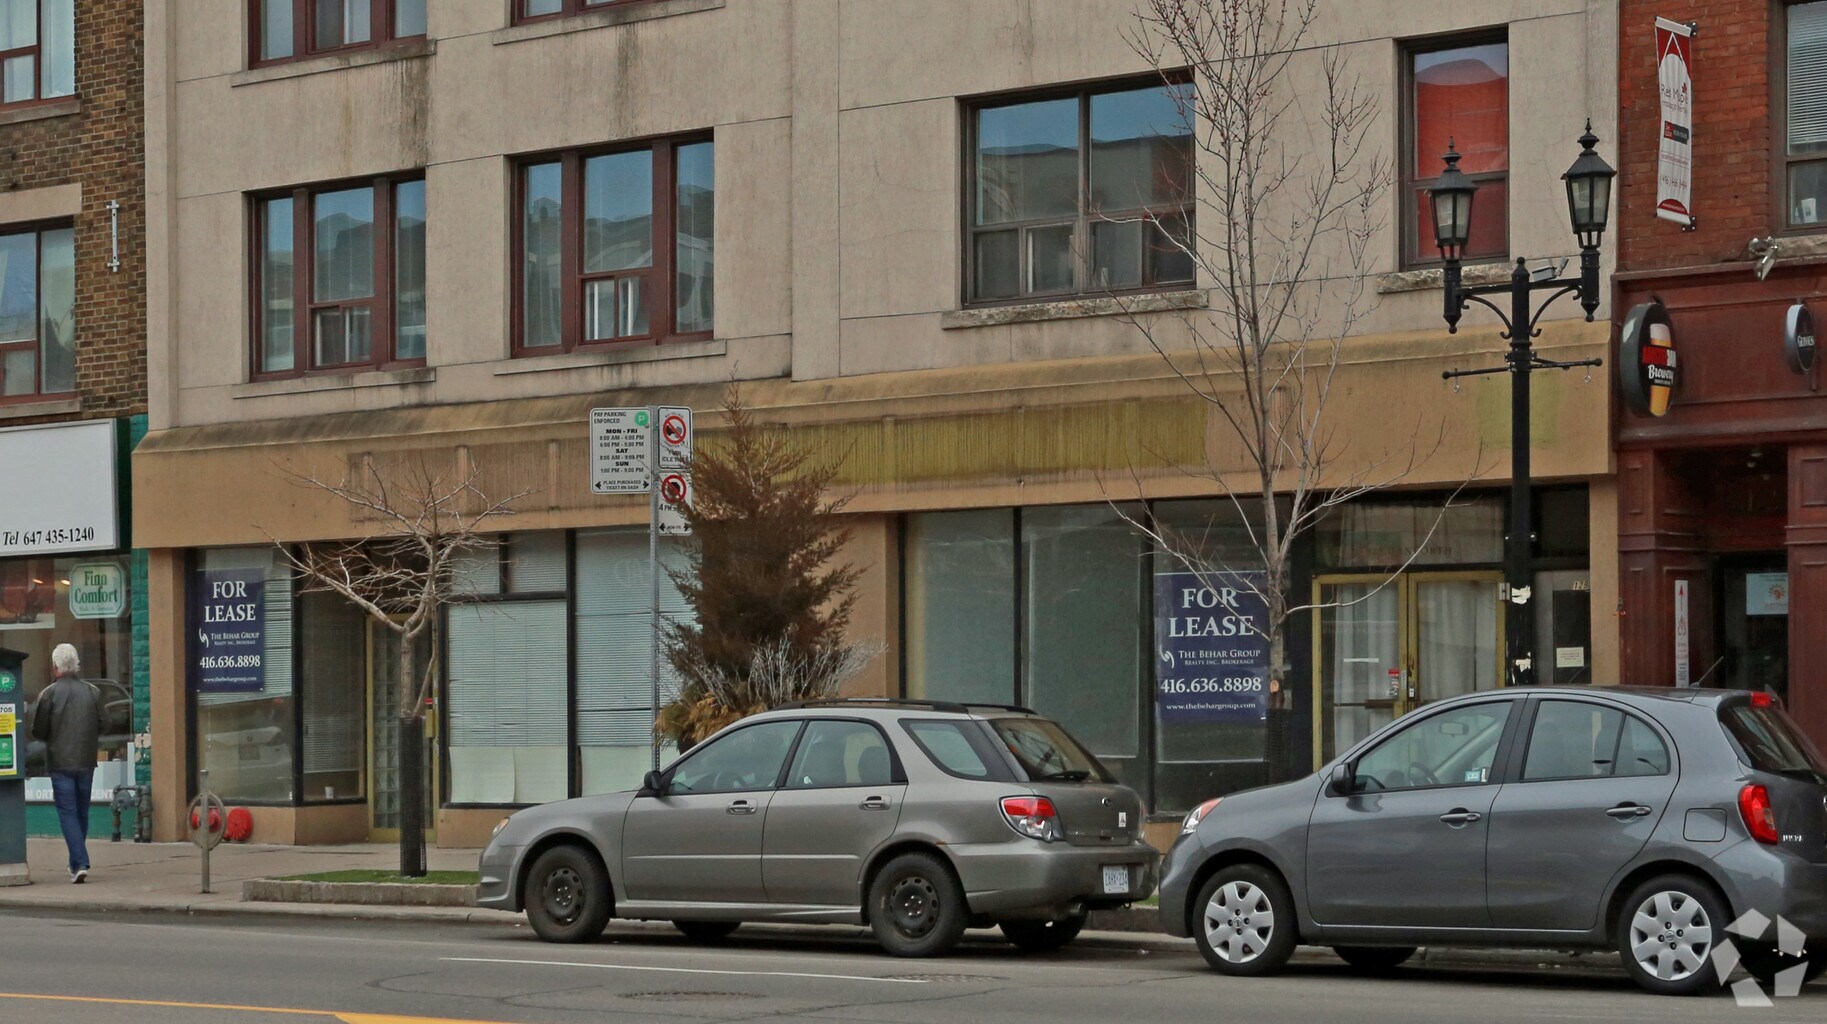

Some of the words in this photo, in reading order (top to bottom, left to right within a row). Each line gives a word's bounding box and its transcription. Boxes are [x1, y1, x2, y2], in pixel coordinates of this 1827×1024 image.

[3, 532, 19, 546] Tel
[24, 531, 42, 546] 647
[45, 526, 94, 544] 435-1240
[84, 571, 107, 586] Finn
[74, 586, 118, 604] Comfort
[212, 580, 247, 598] FOR
[1182, 587, 1239, 608] FOR
[204, 604, 256, 622] LEASE
[1168, 616, 1254, 637] LEASE
[200, 655, 260, 668] 416.636.8898
[1178, 650, 1196, 658] THE
[1200, 650, 1227, 658] BEHAR
[1230, 649, 1260, 658] GROUP
[1160, 677, 1262, 693] 416.636.8898
[1166, 702, 1256, 711] www.thebehargroup.com
